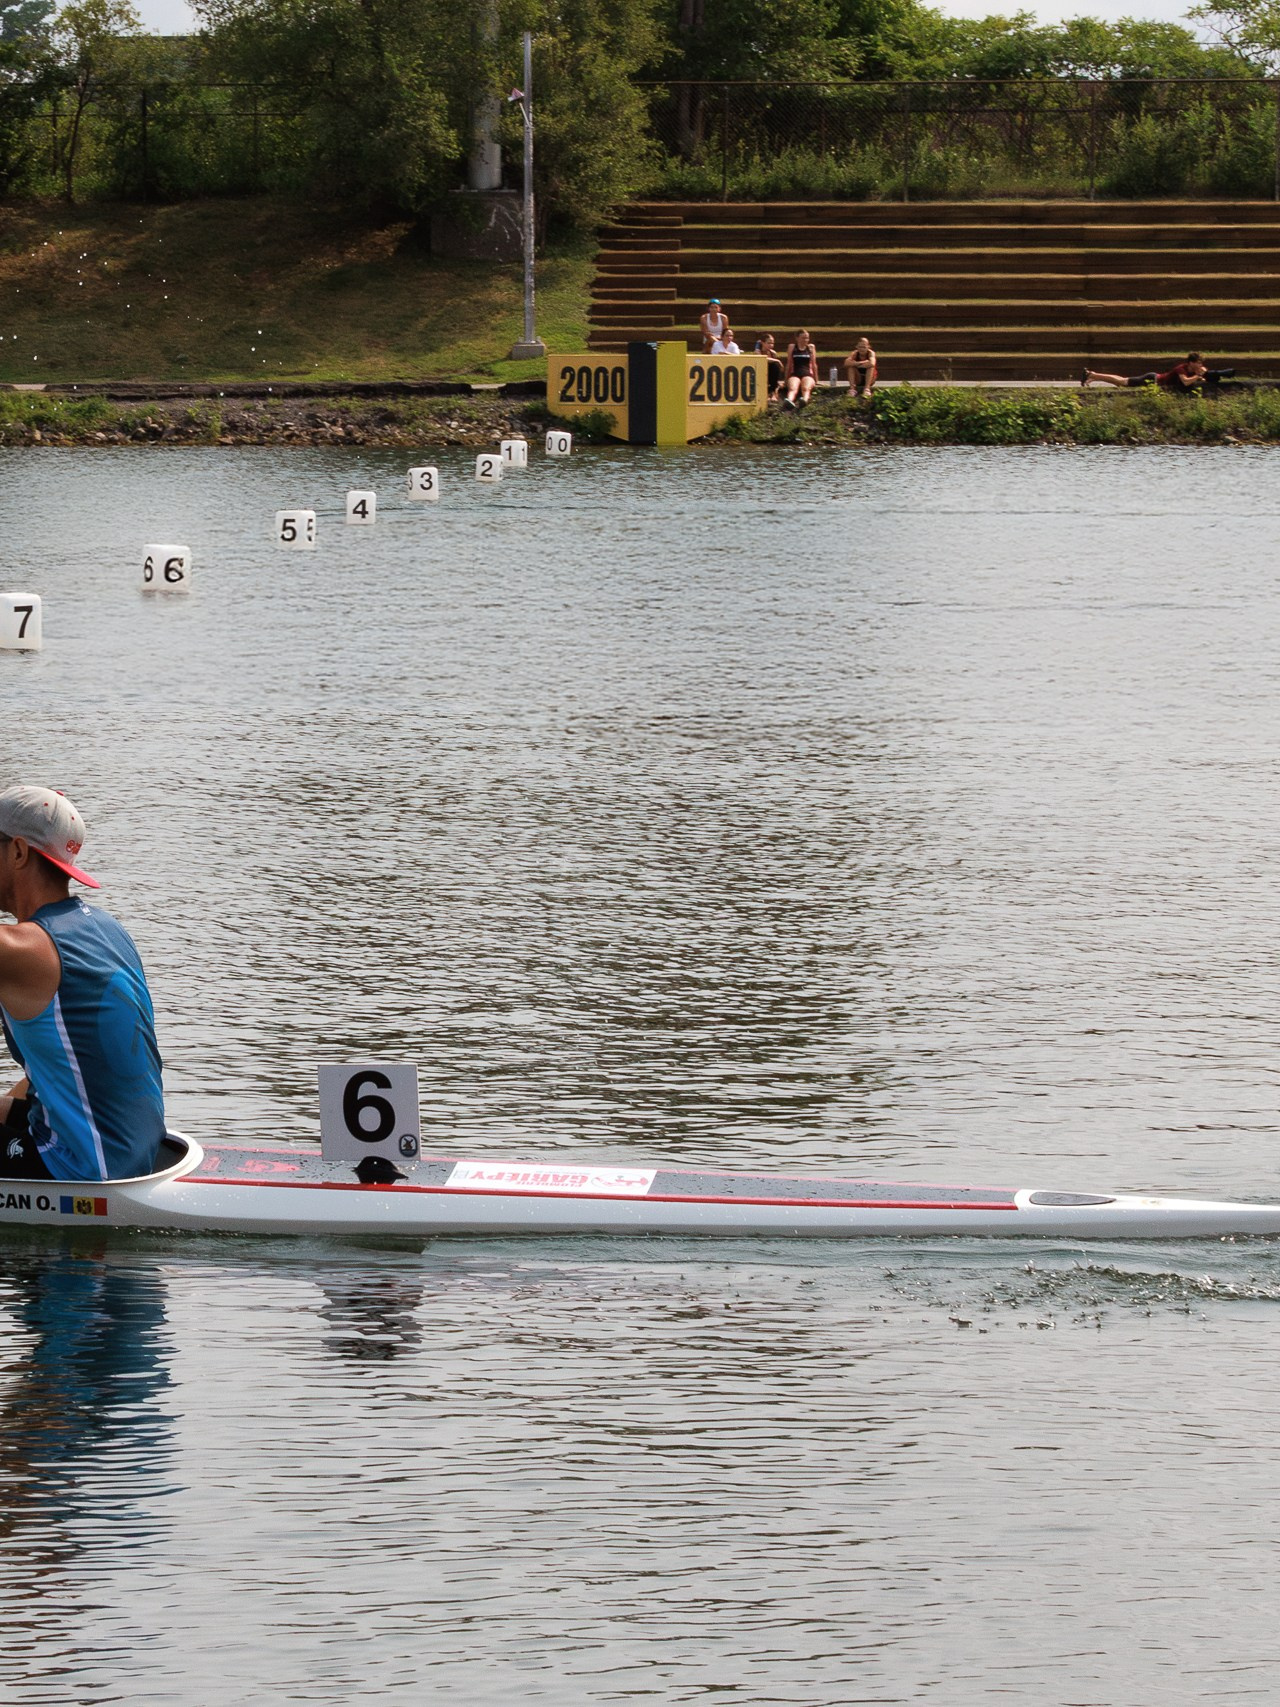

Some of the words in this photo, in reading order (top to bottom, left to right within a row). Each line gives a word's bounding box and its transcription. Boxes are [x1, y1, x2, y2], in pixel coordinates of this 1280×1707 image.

[559, 366, 626, 404] 2000
[689, 365, 757, 403] 2000
[505, 445, 512, 461] 1
[558, 438, 568, 452] 0
[420, 471, 433, 490] 3
[480, 460, 493, 477] 2
[352, 499, 369, 519] 4
[280, 518, 297, 542] 5
[144, 556, 153, 583] 6
[164, 557, 184, 583] 6
[14, 605, 33, 639] 7
[342, 1070, 396, 1143] 6
[36, 1195, 57, 1211] O.
